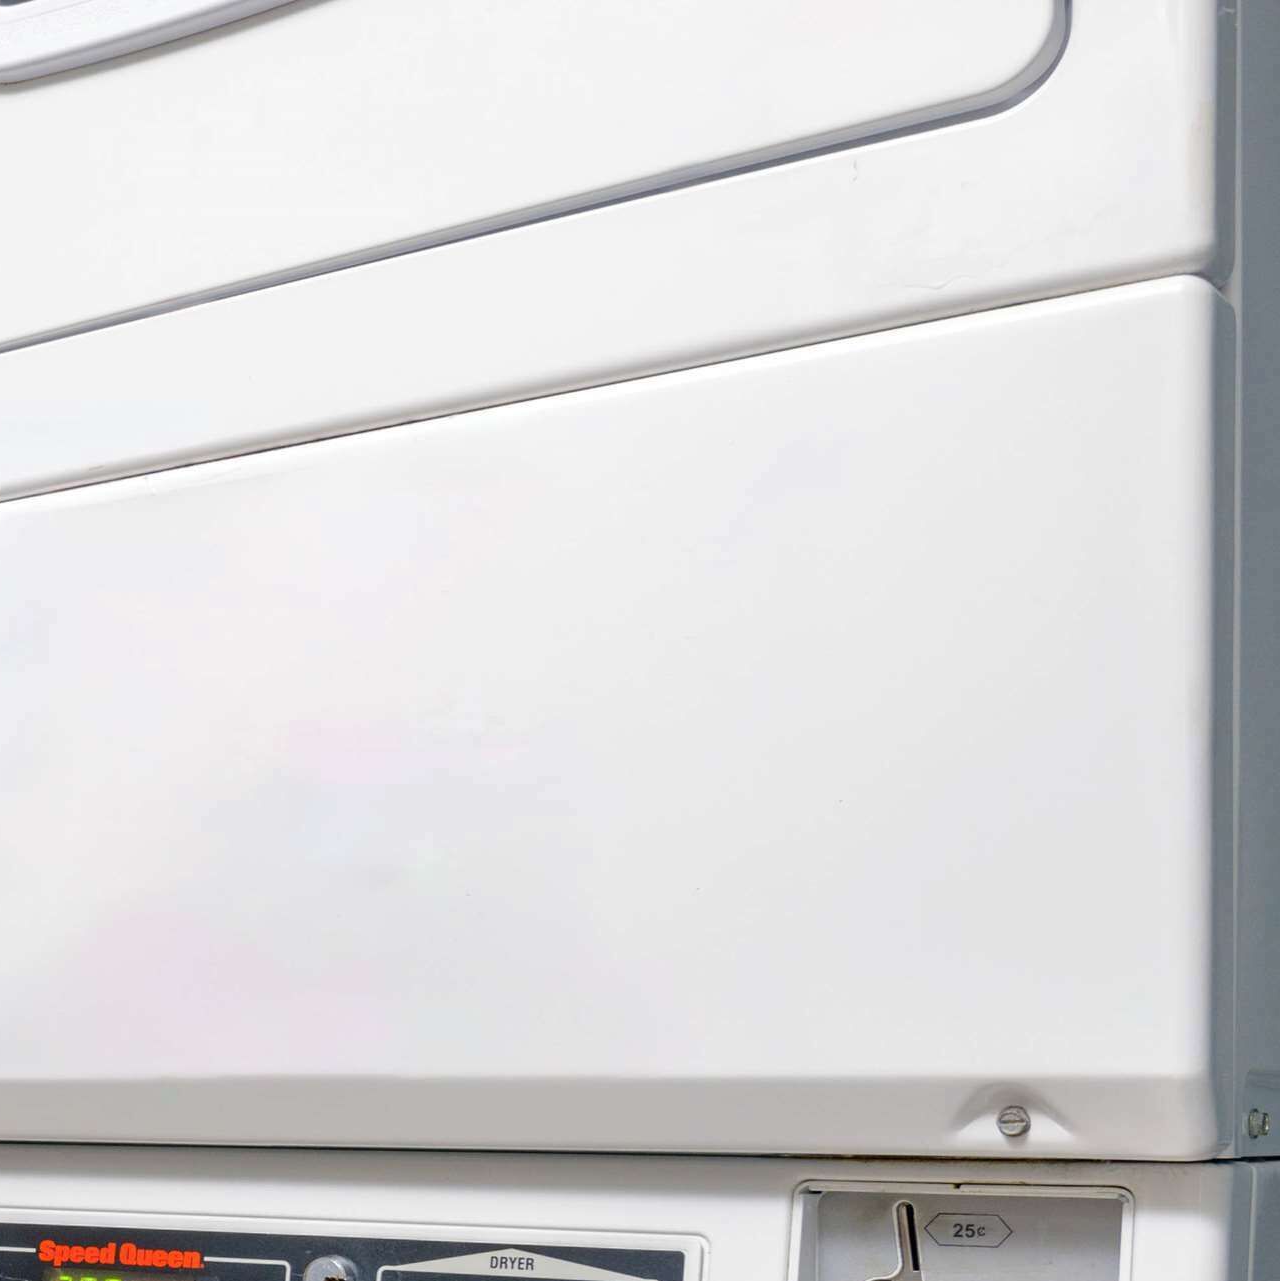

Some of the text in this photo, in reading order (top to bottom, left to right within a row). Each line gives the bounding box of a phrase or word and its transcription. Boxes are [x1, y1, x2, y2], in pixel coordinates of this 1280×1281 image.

[953, 1223, 986, 1238] 25¢
[38, 1239, 116, 1267] Speed
[490, 1256, 535, 1271] DRYER
